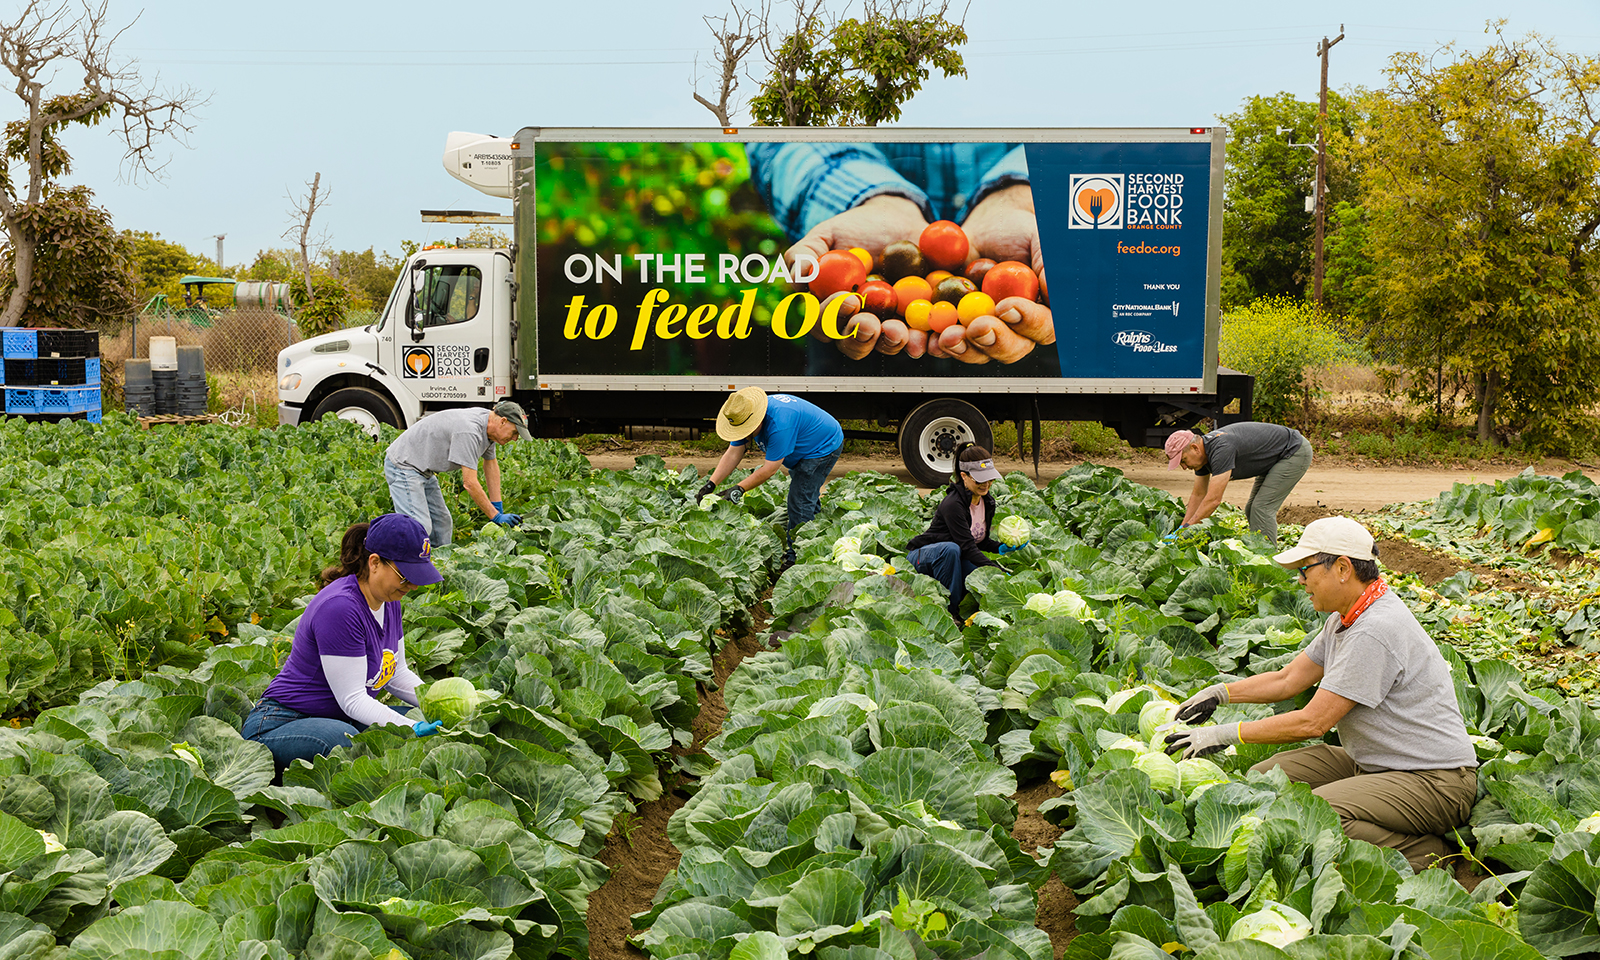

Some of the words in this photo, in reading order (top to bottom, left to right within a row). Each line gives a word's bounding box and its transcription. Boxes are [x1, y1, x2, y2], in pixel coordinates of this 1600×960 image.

[1128, 173, 1184, 184] SECOND
[1128, 184, 1184, 194] HARVEST
[1127, 194, 1183, 209] FOOD
[1127, 209, 1183, 225] BANK
[1117, 241, 1181, 257] feedoc.org
[564, 253, 622, 284] ON
[634, 253, 706, 283] THE
[719, 253, 820, 284] ROAD
[563, 294, 618, 340] to
[630, 288, 758, 351] feed
[770, 292, 868, 340] OC
[1115, 331, 1151, 346] Ralphs
[437, 357, 471, 367] FOOD
[437, 366, 471, 376] BANK
